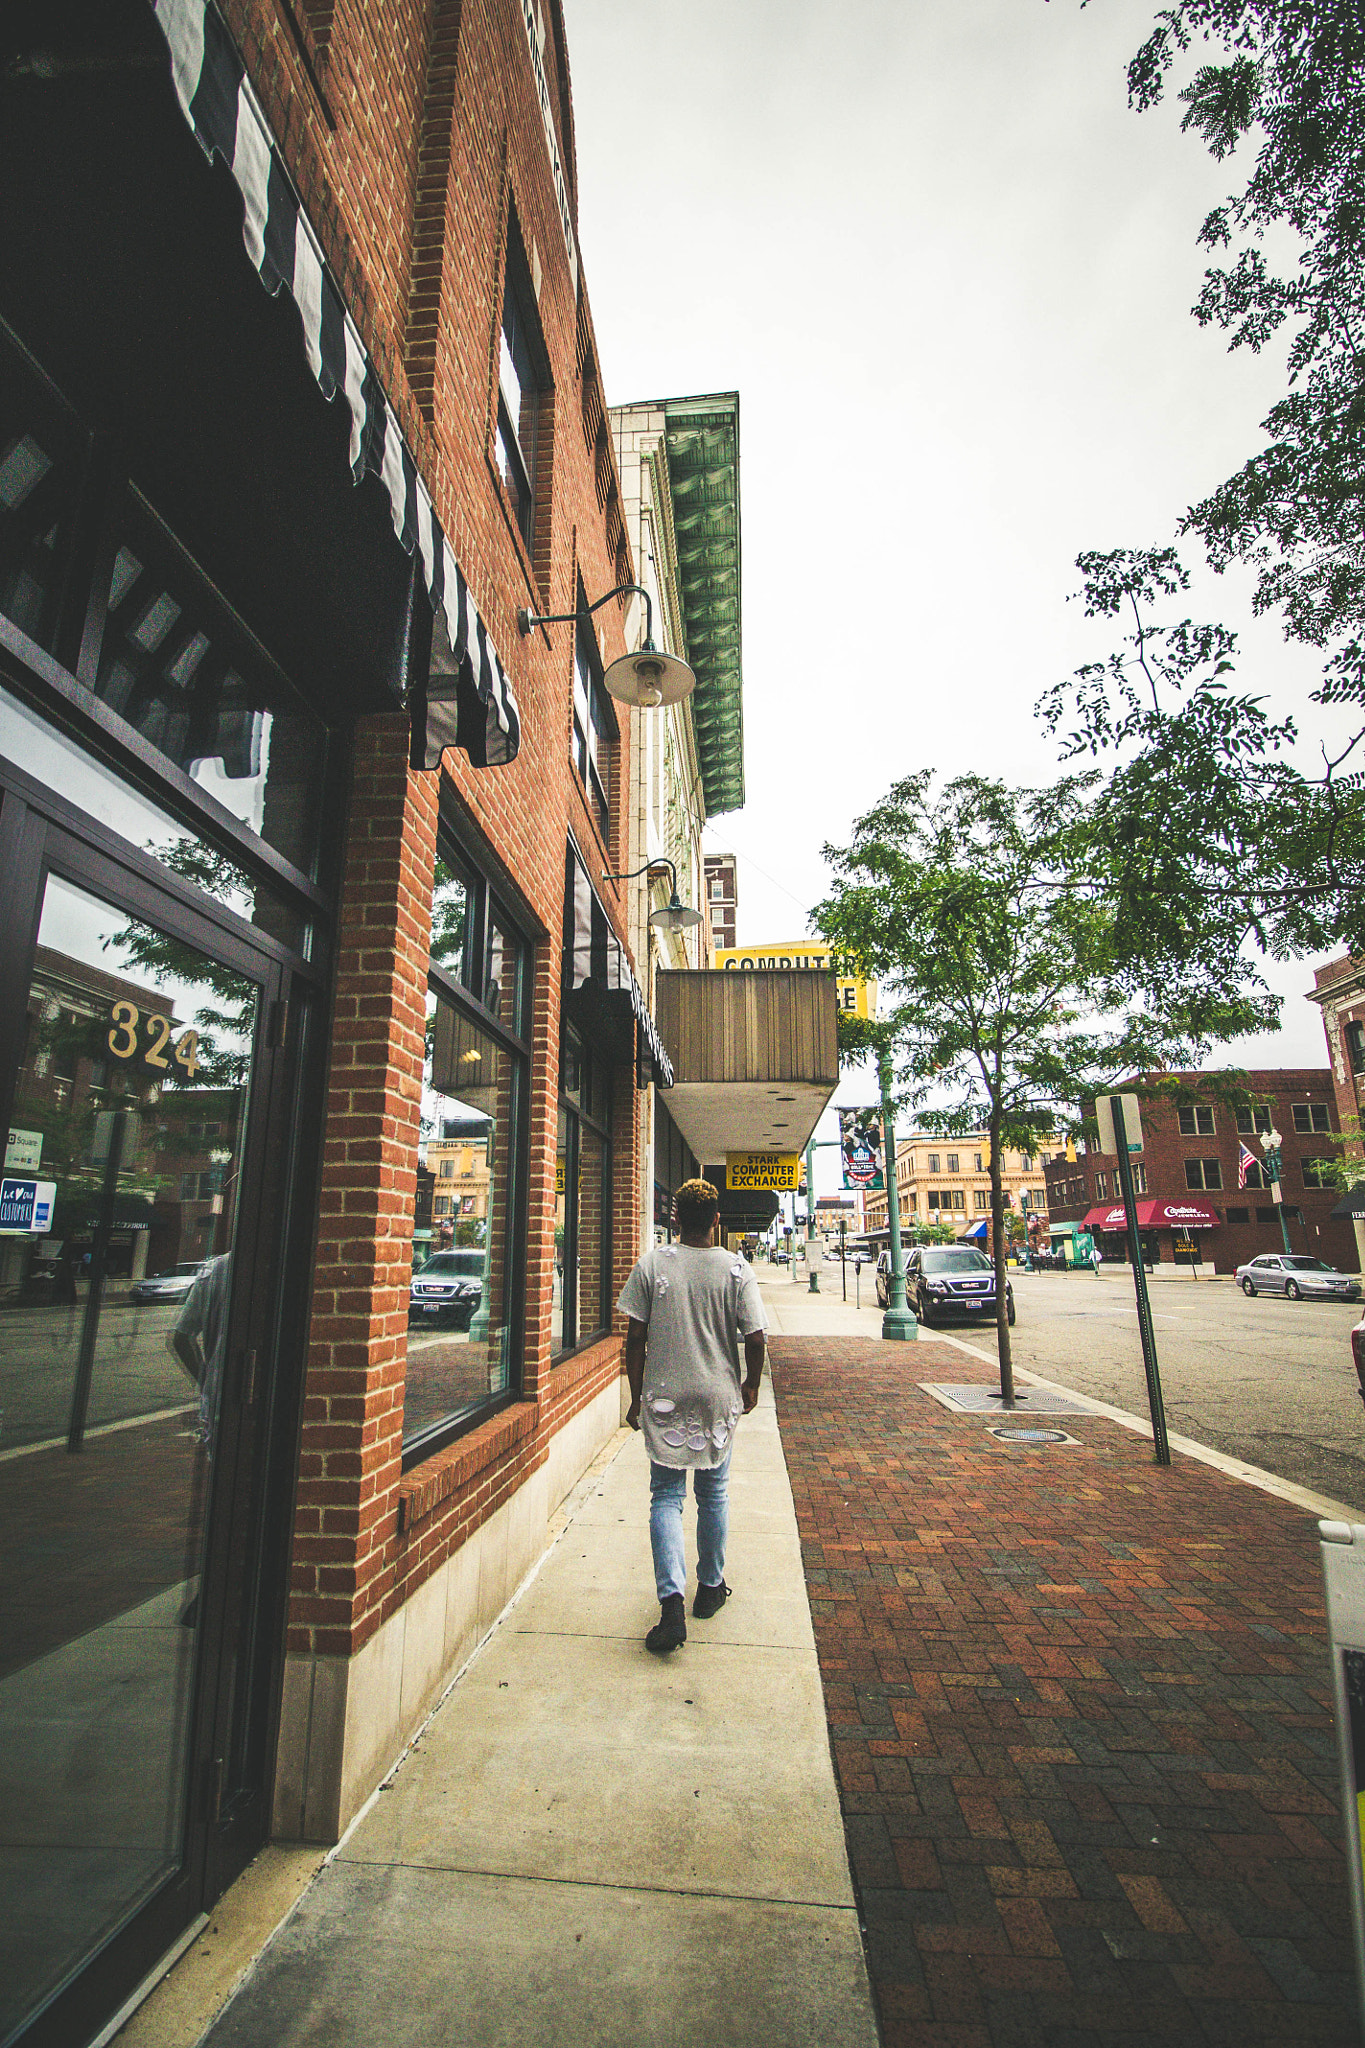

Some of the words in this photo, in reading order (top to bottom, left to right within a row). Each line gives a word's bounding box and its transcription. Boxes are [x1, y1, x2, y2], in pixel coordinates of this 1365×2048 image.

[108, 1000, 201, 1078] 324
[16, 1136, 39, 1147] Square
[747, 1155, 780, 1165] STARK
[732, 1165, 794, 1176] COMPUTER
[732, 1176, 794, 1187] EXCHANGE
[1, 1202, 32, 1221] CUSTOMERS
